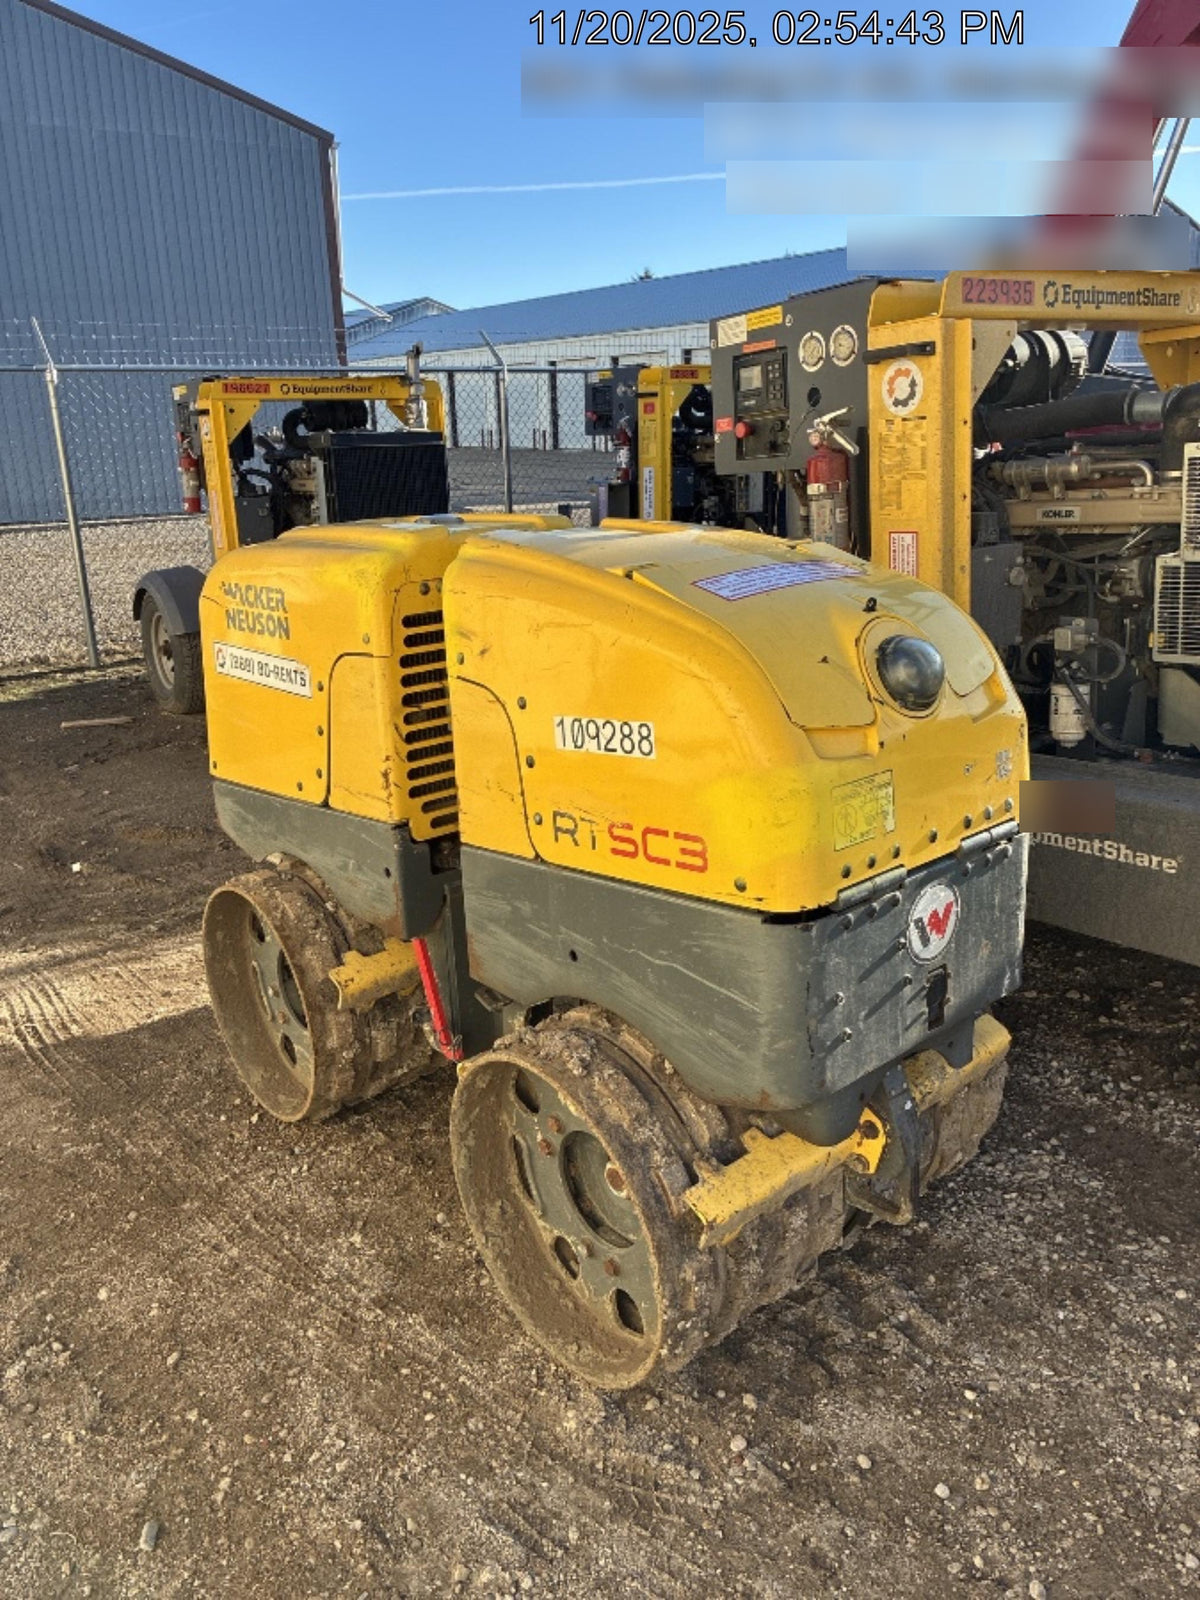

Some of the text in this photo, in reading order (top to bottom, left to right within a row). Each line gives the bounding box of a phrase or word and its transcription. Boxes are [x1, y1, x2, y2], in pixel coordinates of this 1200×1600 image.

[962, 277, 1034, 305] 223935
[1061, 283, 1181, 310] EquipmentShare
[225, 607, 291, 640] NEUSON
[556, 716, 654, 757] 109288
